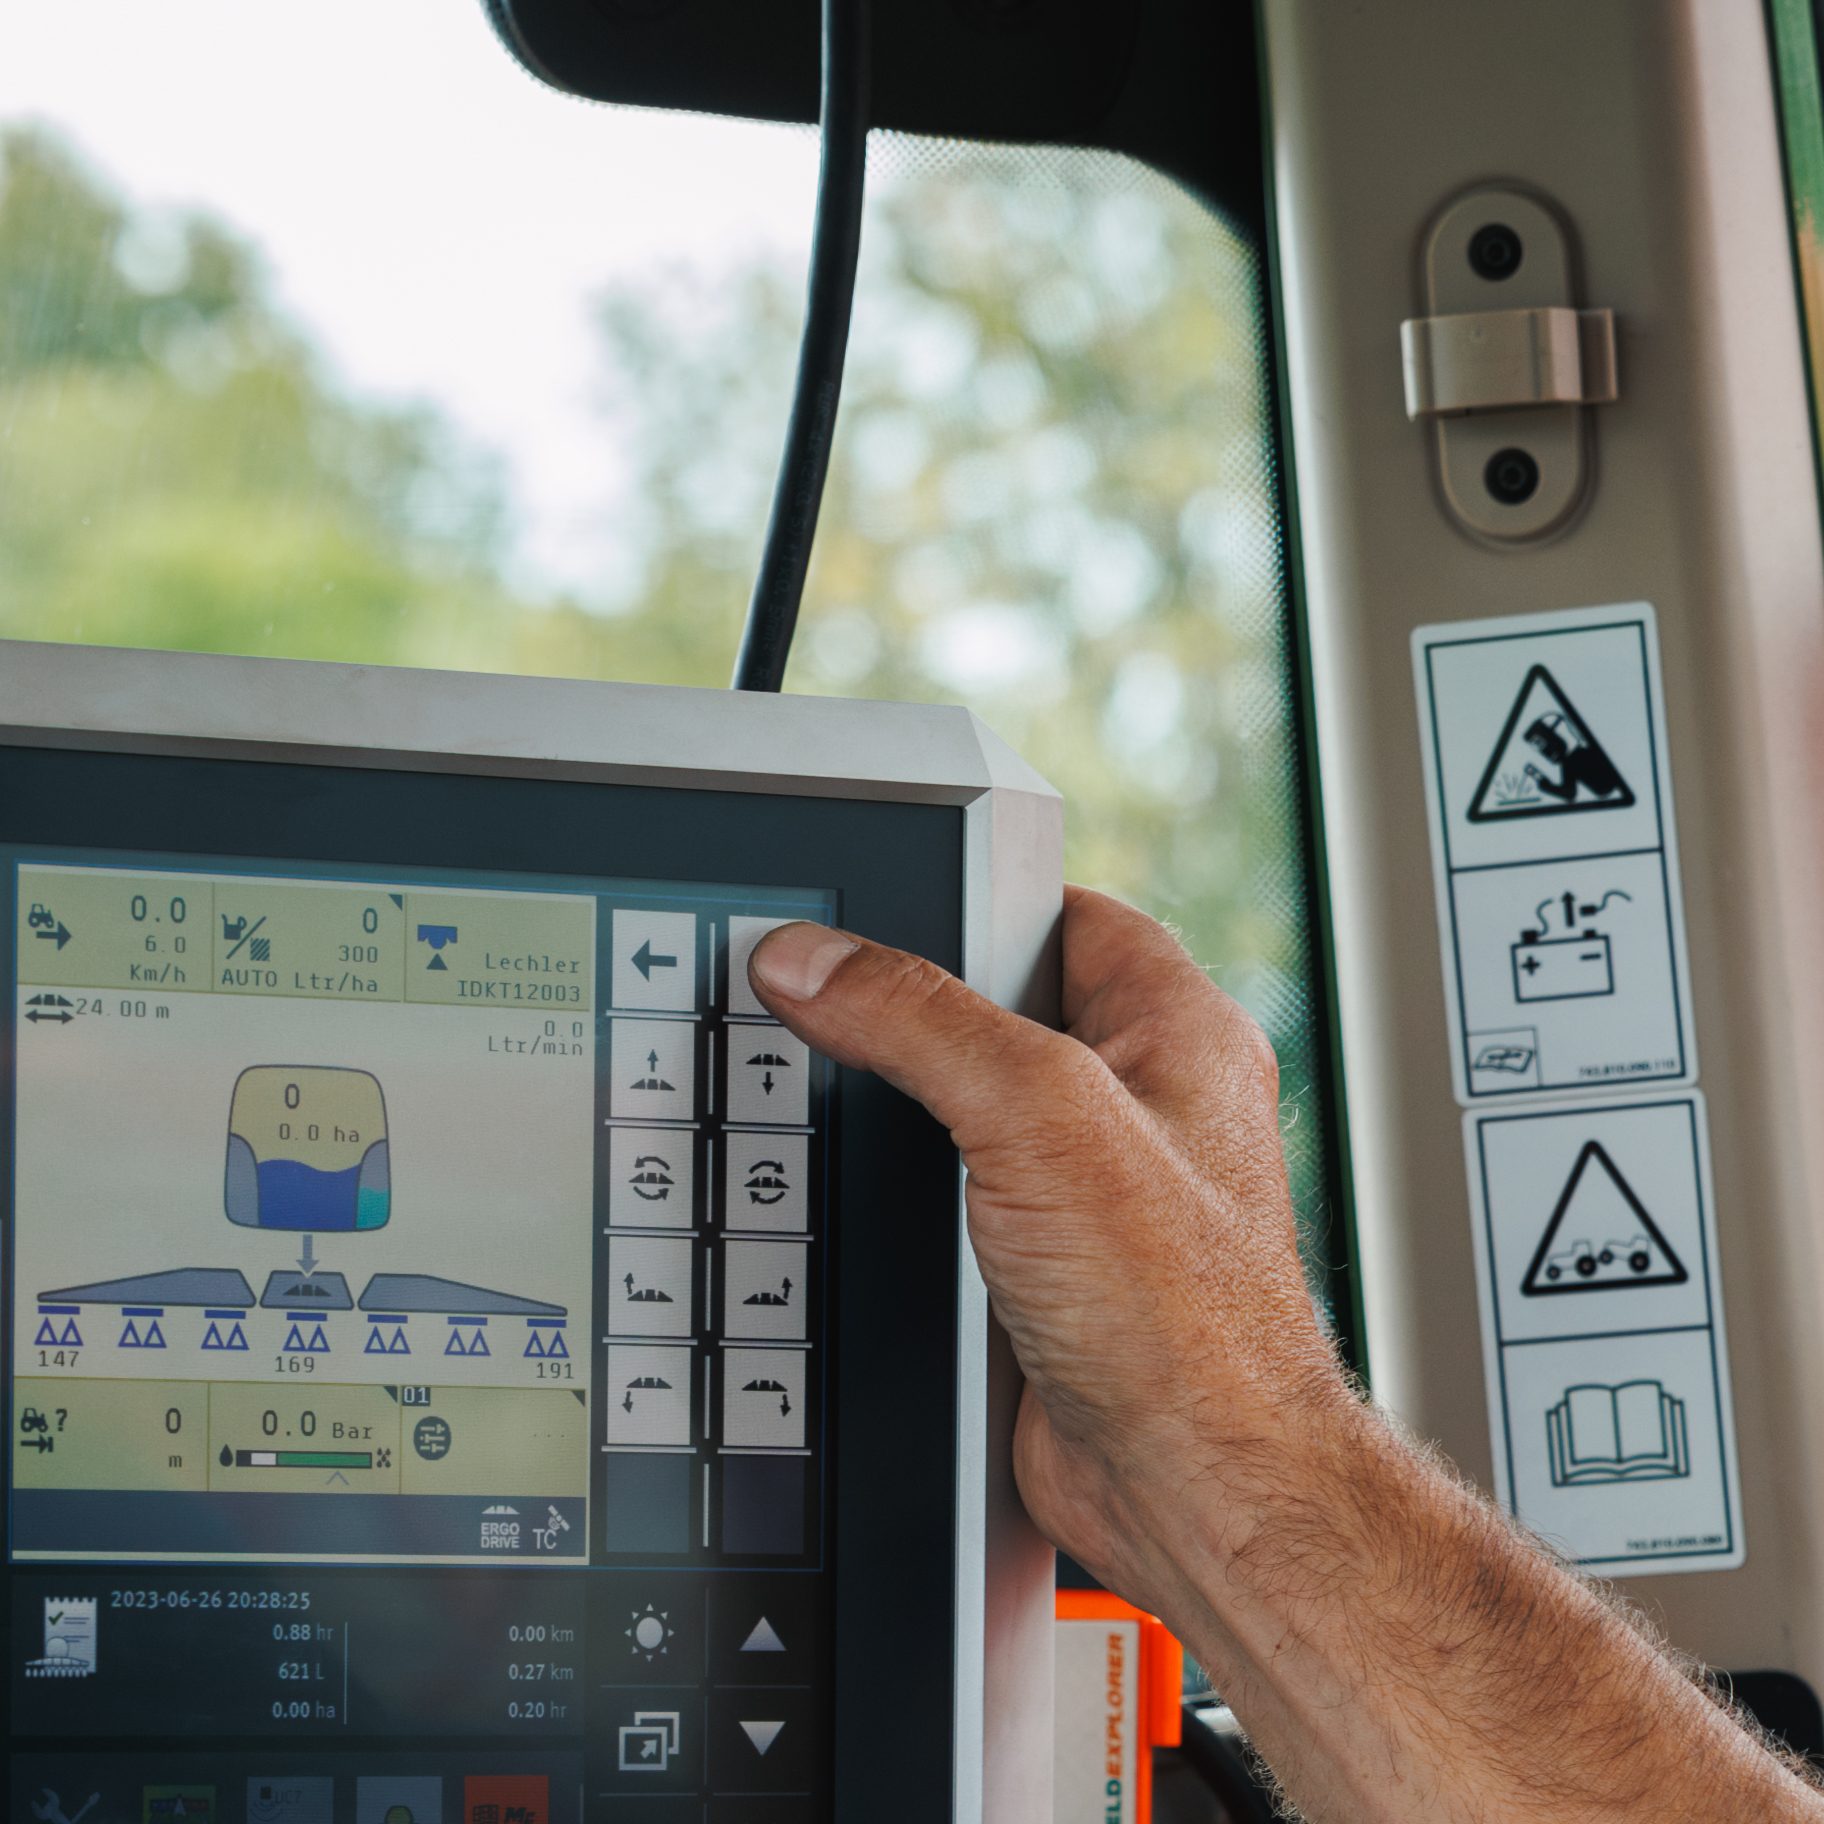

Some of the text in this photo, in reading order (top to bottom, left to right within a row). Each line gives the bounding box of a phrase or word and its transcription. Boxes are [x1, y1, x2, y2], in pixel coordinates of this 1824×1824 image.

[130, 894, 186, 924] 0.0
[362, 907, 378, 934] 0
[144, 935, 186, 954] 6.0
[337, 945, 378, 963] 300
[129, 963, 186, 984] Km/h
[485, 953, 581, 975] Lechler
[221, 969, 378, 993] AUTO Ltr/ha
[457, 980, 581, 1003] IDKT12003
[75, 998, 170, 1019] 24.00 m
[543, 1020, 584, 1038] 0.0
[488, 1035, 584, 1056] Ltr/min
[284, 1083, 300, 1109] 0
[278, 1123, 360, 1144] 0.0 ha
[37, 1350, 80, 1369] 147
[275, 1356, 315, 1374] 169
[536, 1362, 575, 1379] 191
[402, 1386, 429, 1404] 01
[165, 1407, 182, 1434] 0
[262, 1409, 373, 1440] 0.0 Bar
[169, 1454, 183, 1468] m
[480, 1522, 520, 1537] ERGO
[480, 1535, 520, 1549] DRIVE
[532, 1529, 558, 1550] TC
[110, 1590, 311, 1611] 2023-06-26 20:28:25
[272, 1623, 333, 1642] 0.88 hr
[508, 1624, 574, 1643] 0.00 km
[278, 1662, 325, 1680] 621 L
[508, 1662, 574, 1681] 0.27 km
[272, 1701, 336, 1719] 0.00 ha
[508, 1701, 567, 1719] 0.20 hr
